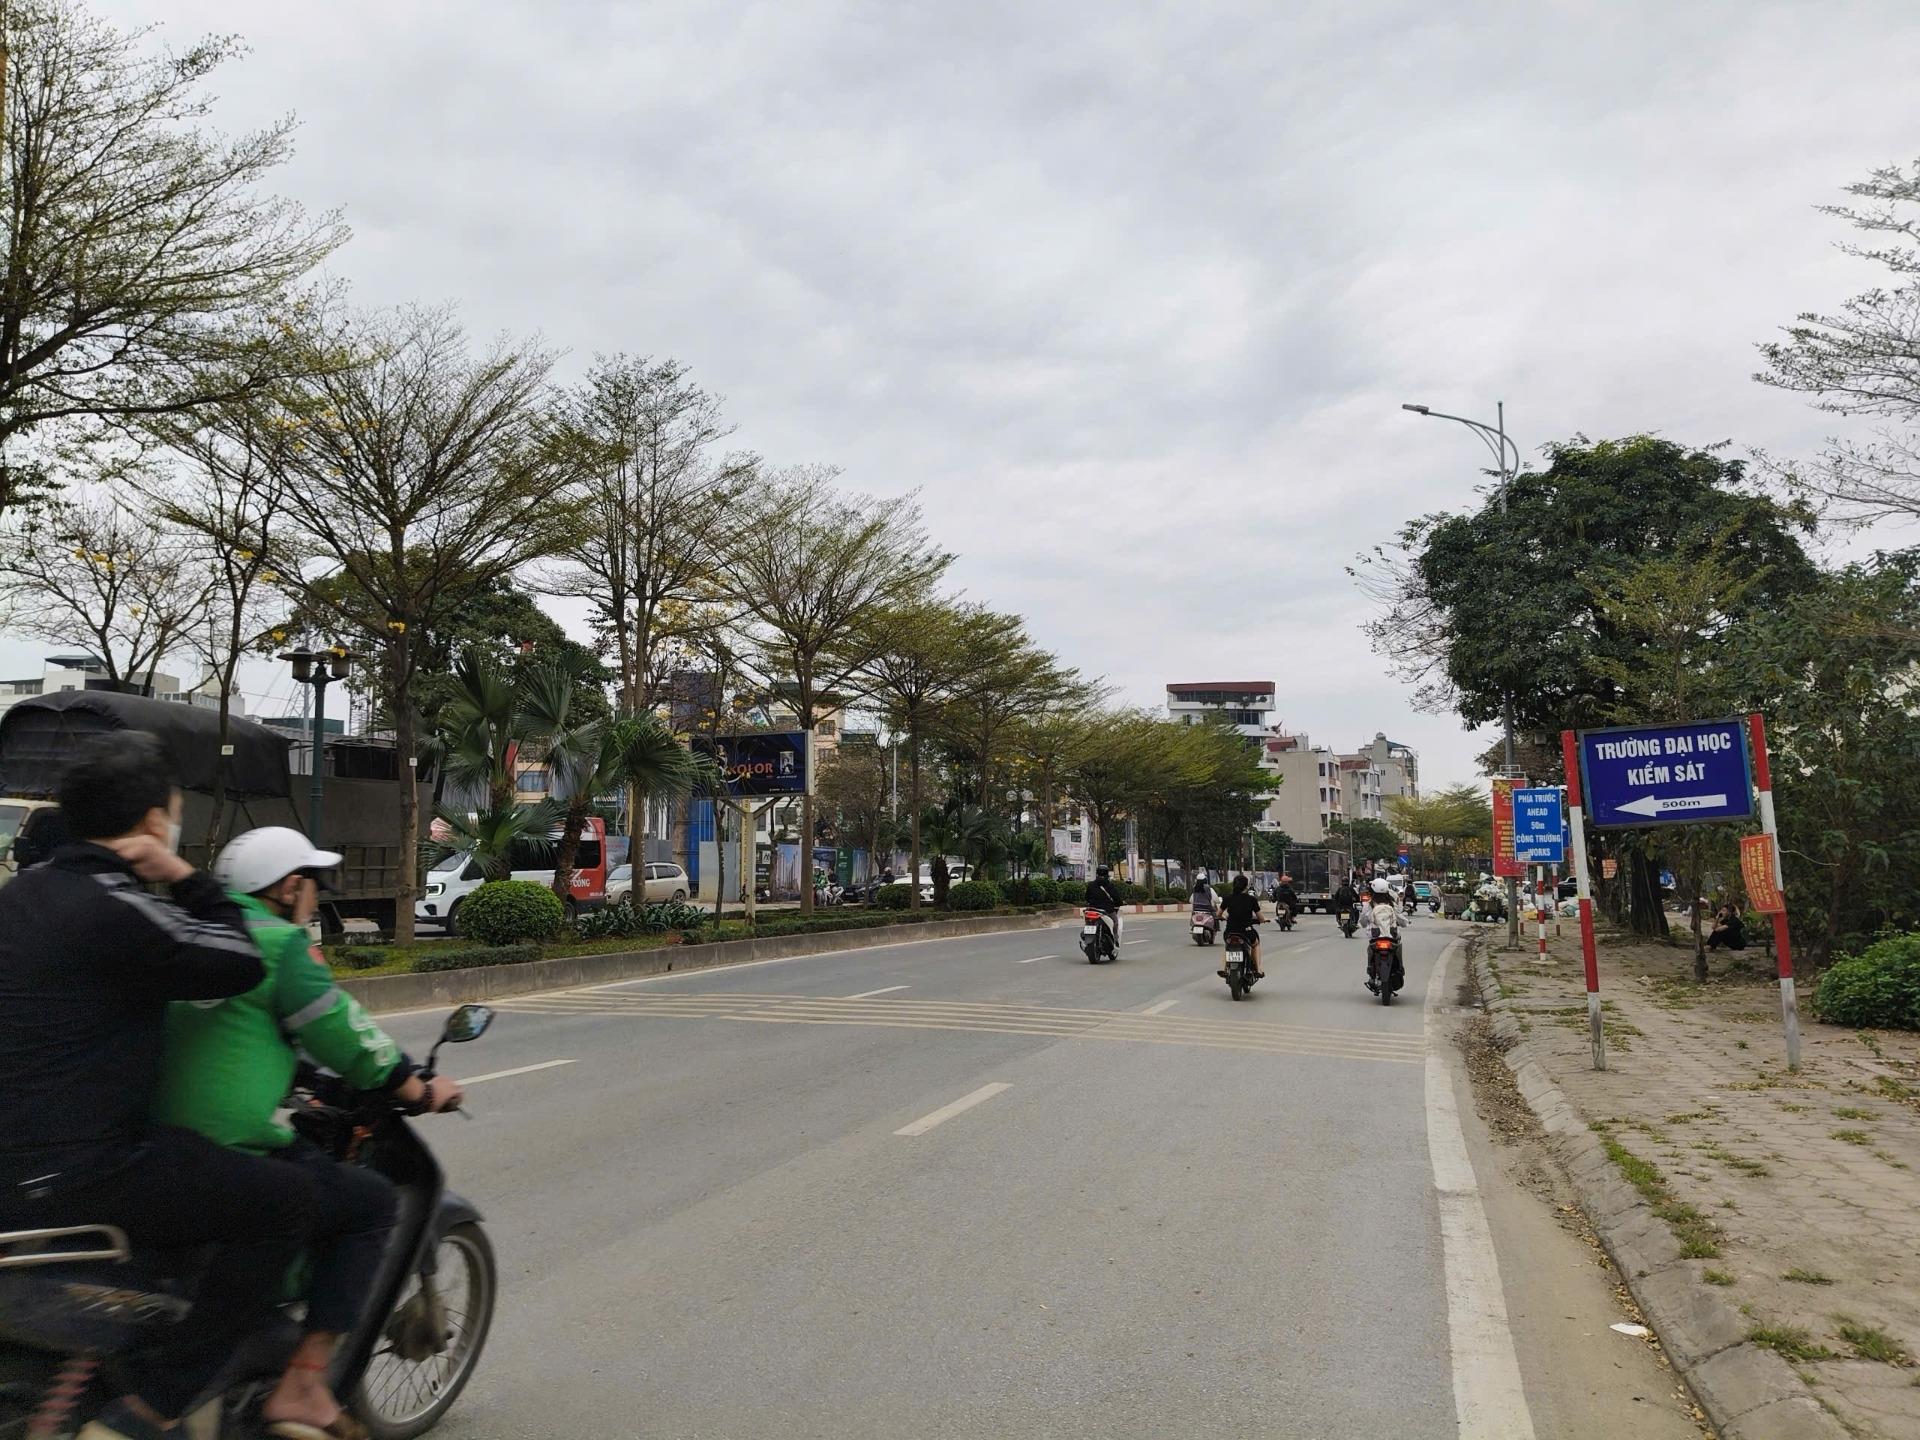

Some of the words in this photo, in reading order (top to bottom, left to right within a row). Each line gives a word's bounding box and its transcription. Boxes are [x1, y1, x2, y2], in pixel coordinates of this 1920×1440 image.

[1595, 737, 1661, 760] TRƯỜNG
[1664, 736, 1693, 756] ĐẠI
[1697, 733, 1731, 754] HỌC
[1627, 761, 1670, 786] KIỂM
[1674, 761, 1705, 782] SÁT
[1517, 793, 1533, 803] PHÍA
[1662, 800, 1701, 808] 500m
[1527, 808, 1548, 816] AHEAD
[1531, 821, 1545, 830] 50m
[1516, 833, 1534, 843] CÔNG
[1528, 848, 1551, 857] WORKS
